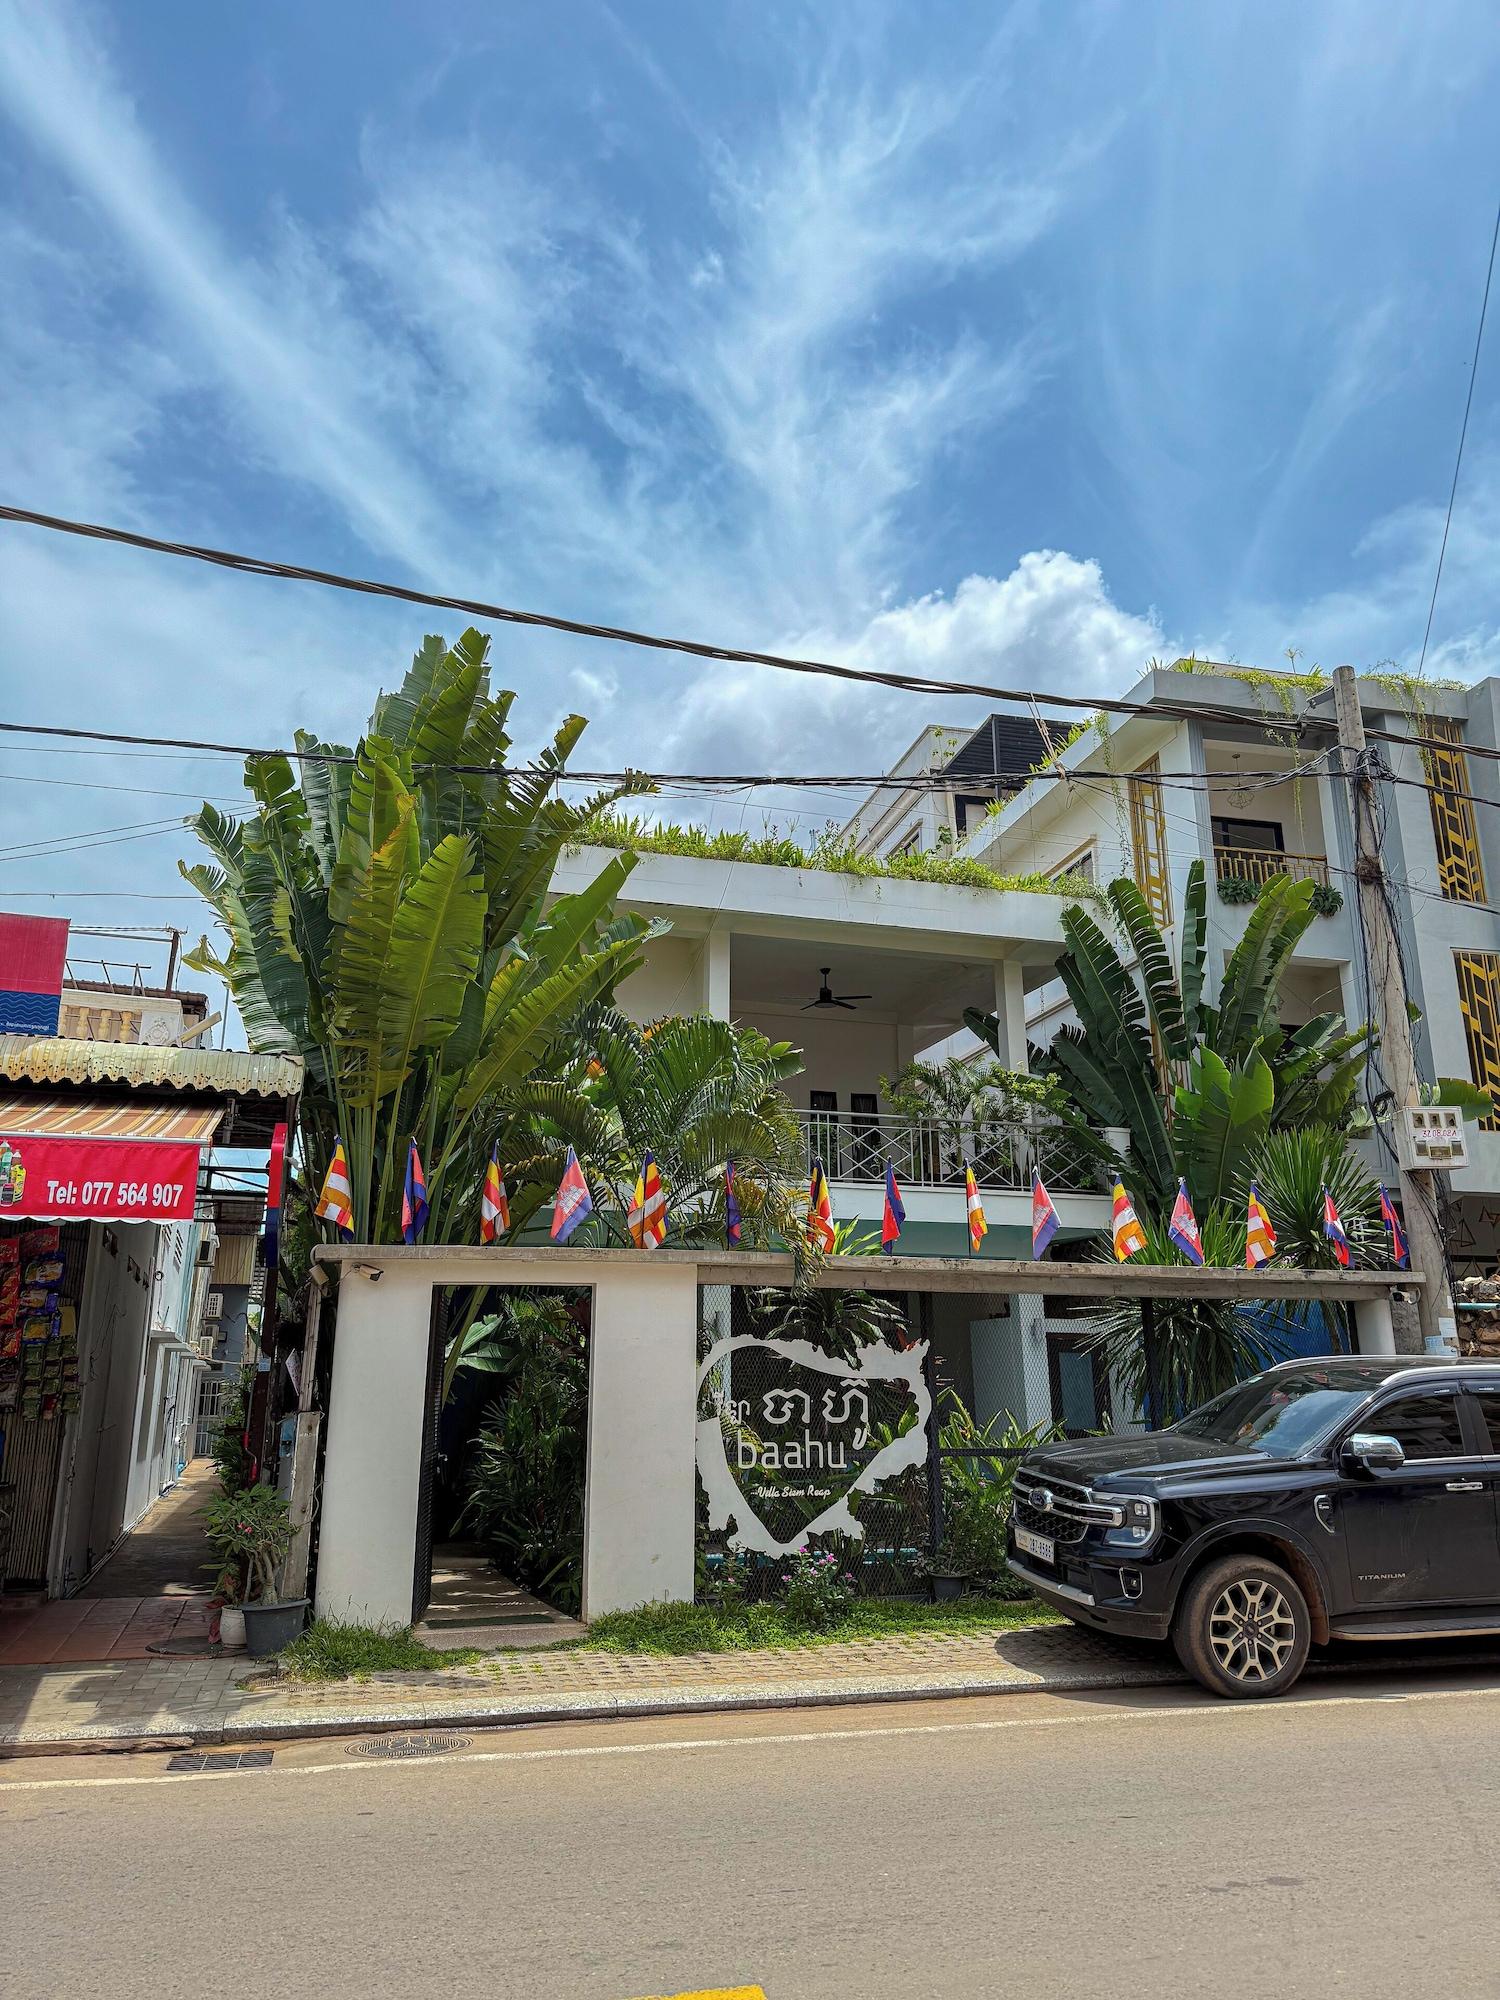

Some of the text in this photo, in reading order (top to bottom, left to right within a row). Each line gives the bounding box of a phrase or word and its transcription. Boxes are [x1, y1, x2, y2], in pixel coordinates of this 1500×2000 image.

[47, 1180, 184, 1207] Tel: 077 564 907
[737, 1428, 847, 1469] baahu
[757, 1484, 831, 1500] Villa Siem Reap
[1357, 1573, 1406, 1581] TITANIUM
